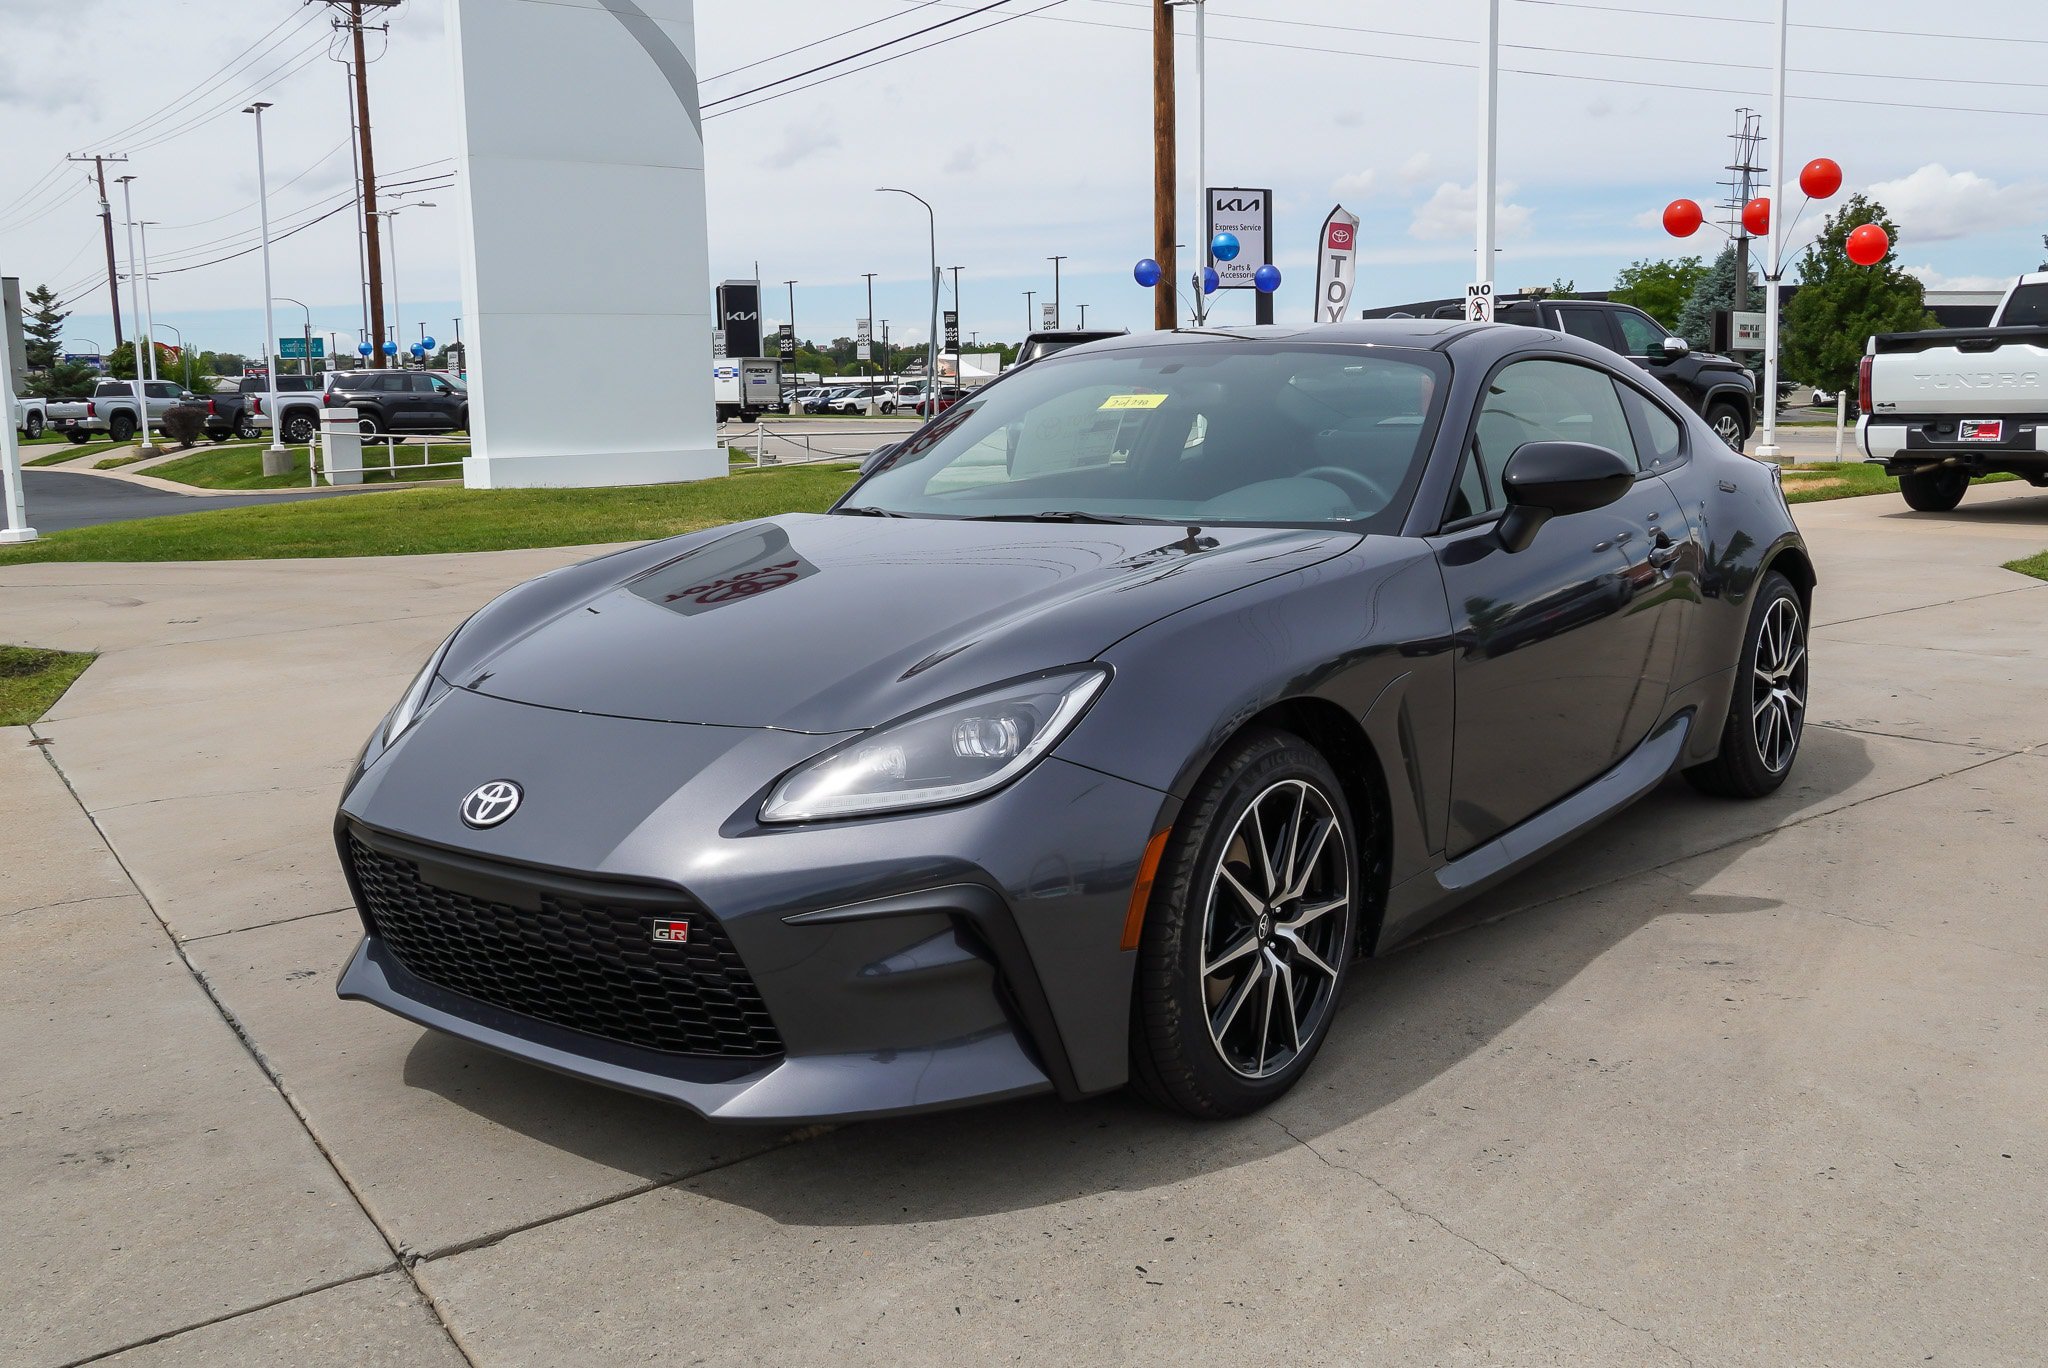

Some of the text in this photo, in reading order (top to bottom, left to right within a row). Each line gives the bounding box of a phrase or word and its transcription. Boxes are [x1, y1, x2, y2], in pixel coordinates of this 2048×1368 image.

[1216, 198, 1260, 212] KIA
[1215, 223, 1262, 232] Express Service
[1227, 263, 1251, 272] Parts &
[1220, 271, 1256, 279] Accessorie
[1468, 284, 1491, 297] NO
[726, 311, 757, 321] KIA
[1913, 371, 2040, 390] TUNDRA
[655, 928, 686, 941] GR
